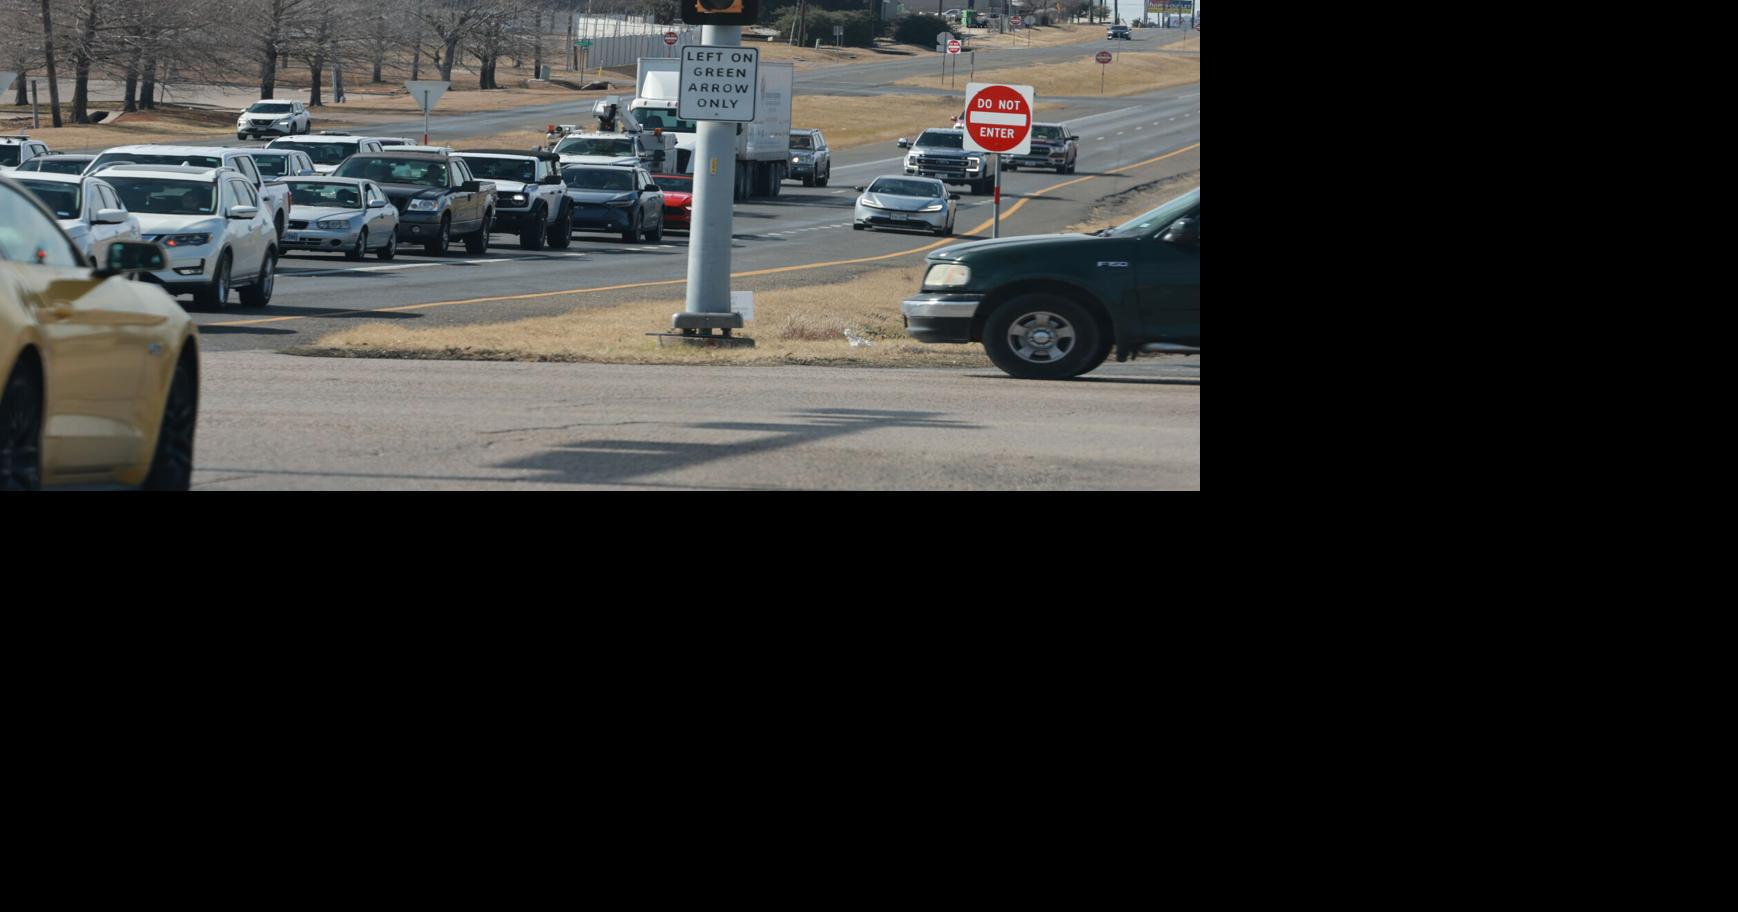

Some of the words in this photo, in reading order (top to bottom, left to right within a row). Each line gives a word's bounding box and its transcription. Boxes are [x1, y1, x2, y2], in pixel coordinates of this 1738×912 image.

[687, 51, 723, 62] LEFT
[731, 52, 753, 63] ON
[693, 67, 746, 78] GREEN
[688, 83, 749, 94] ARROW
[697, 98, 738, 109] ONLY
[977, 98, 993, 109] DO
[998, 99, 1020, 111] NOT
[979, 126, 1015, 139] ENTER
